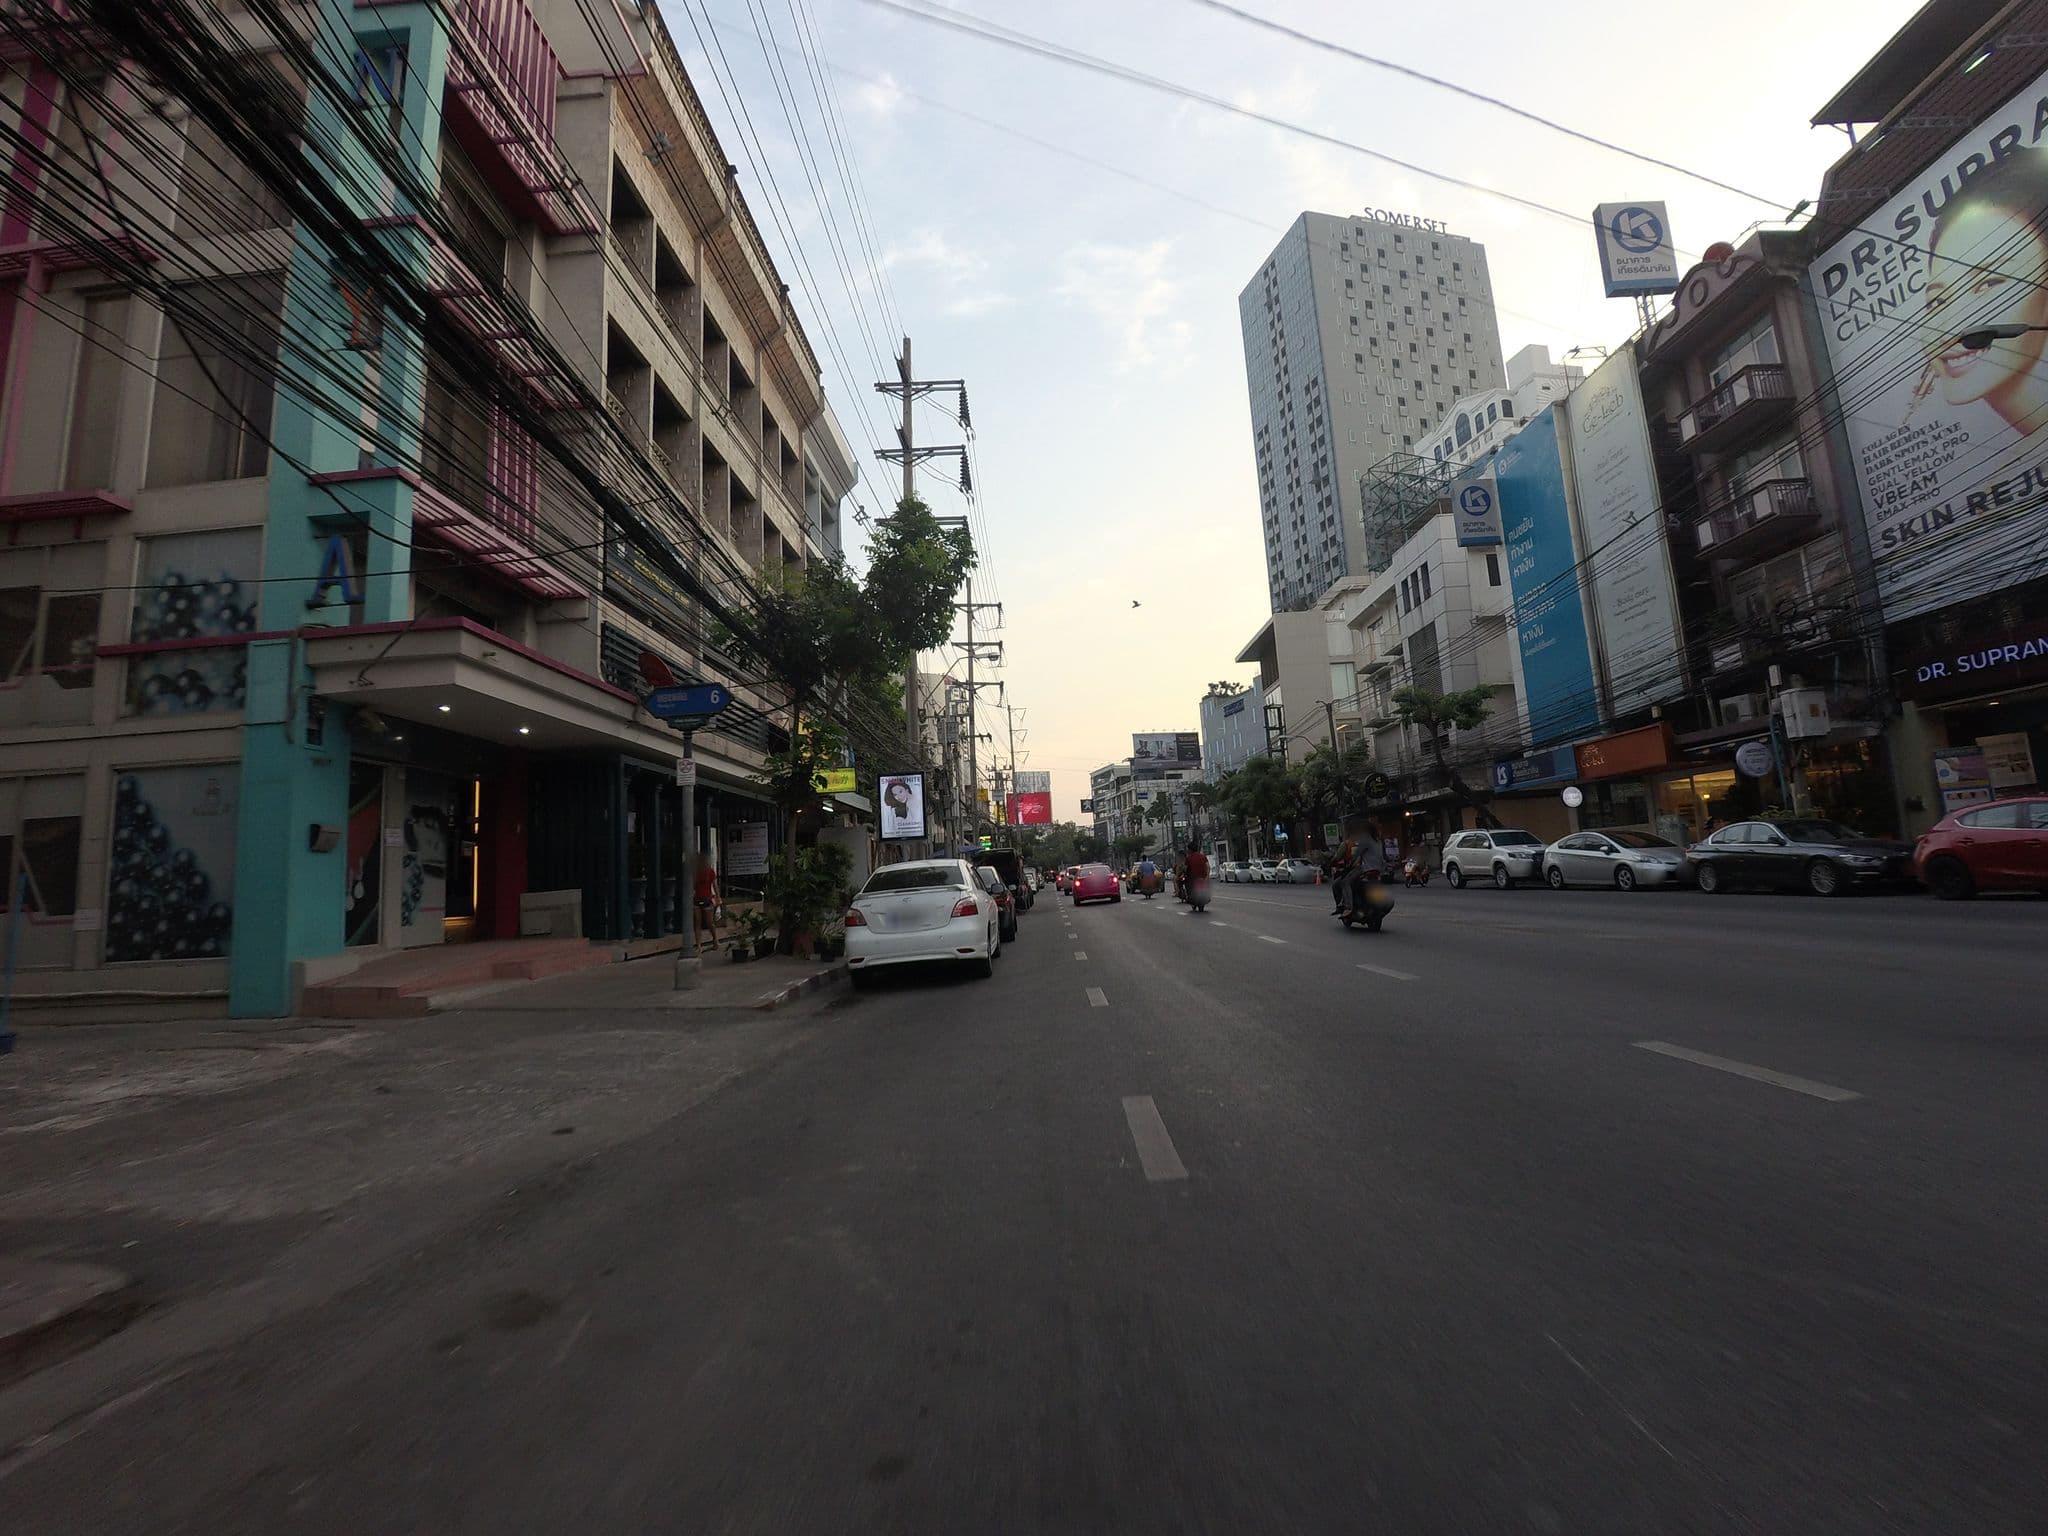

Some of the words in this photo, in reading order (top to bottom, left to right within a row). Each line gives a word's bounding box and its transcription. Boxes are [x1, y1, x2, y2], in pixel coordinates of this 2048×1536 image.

[1363, 206, 1448, 235] SOMERSET
[1616, 256, 1651, 265] ธนาคาร
[1828, 243, 1922, 322] LASER
[1836, 268, 1928, 342] CLINIC
[1867, 445, 1939, 487] GENTLEMAX
[1942, 431, 1970, 451] PRO
[1870, 477, 1901, 497] DUAL
[1902, 450, 1956, 481] YELLOW
[1873, 470, 1939, 510] VBEAM
[1876, 500, 1908, 521] EMAX
[1880, 502, 1954, 549] SKIN
[1510, 535, 1534, 561] ทำงาน
[1513, 555, 1536, 579] หาเงิน
[1522, 622, 1545, 644] หาเงิน
[1917, 661, 1952, 683] DR.
[710, 689, 721, 704] 6
